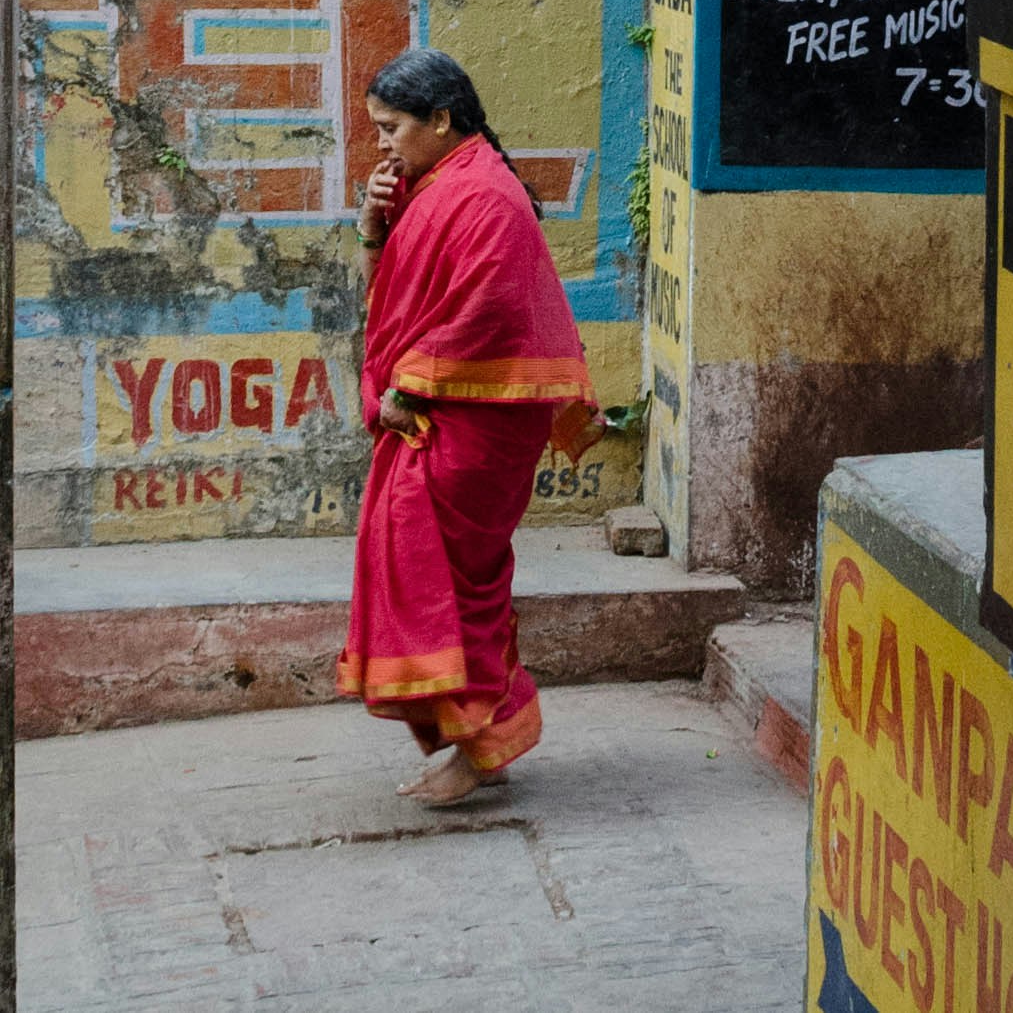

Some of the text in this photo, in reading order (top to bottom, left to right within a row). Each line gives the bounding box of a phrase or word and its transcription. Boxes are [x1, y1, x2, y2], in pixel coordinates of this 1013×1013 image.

[664, 48, 683, 96] THE
[786, 17, 869, 65] FREE
[653, 104, 689, 183] SCHOOL
[663, 187, 677, 254] OF
[651, 262, 681, 344] MUSIC
[112, 358, 339, 448] YOGA
[820, 756, 967, 1013] GUEST
